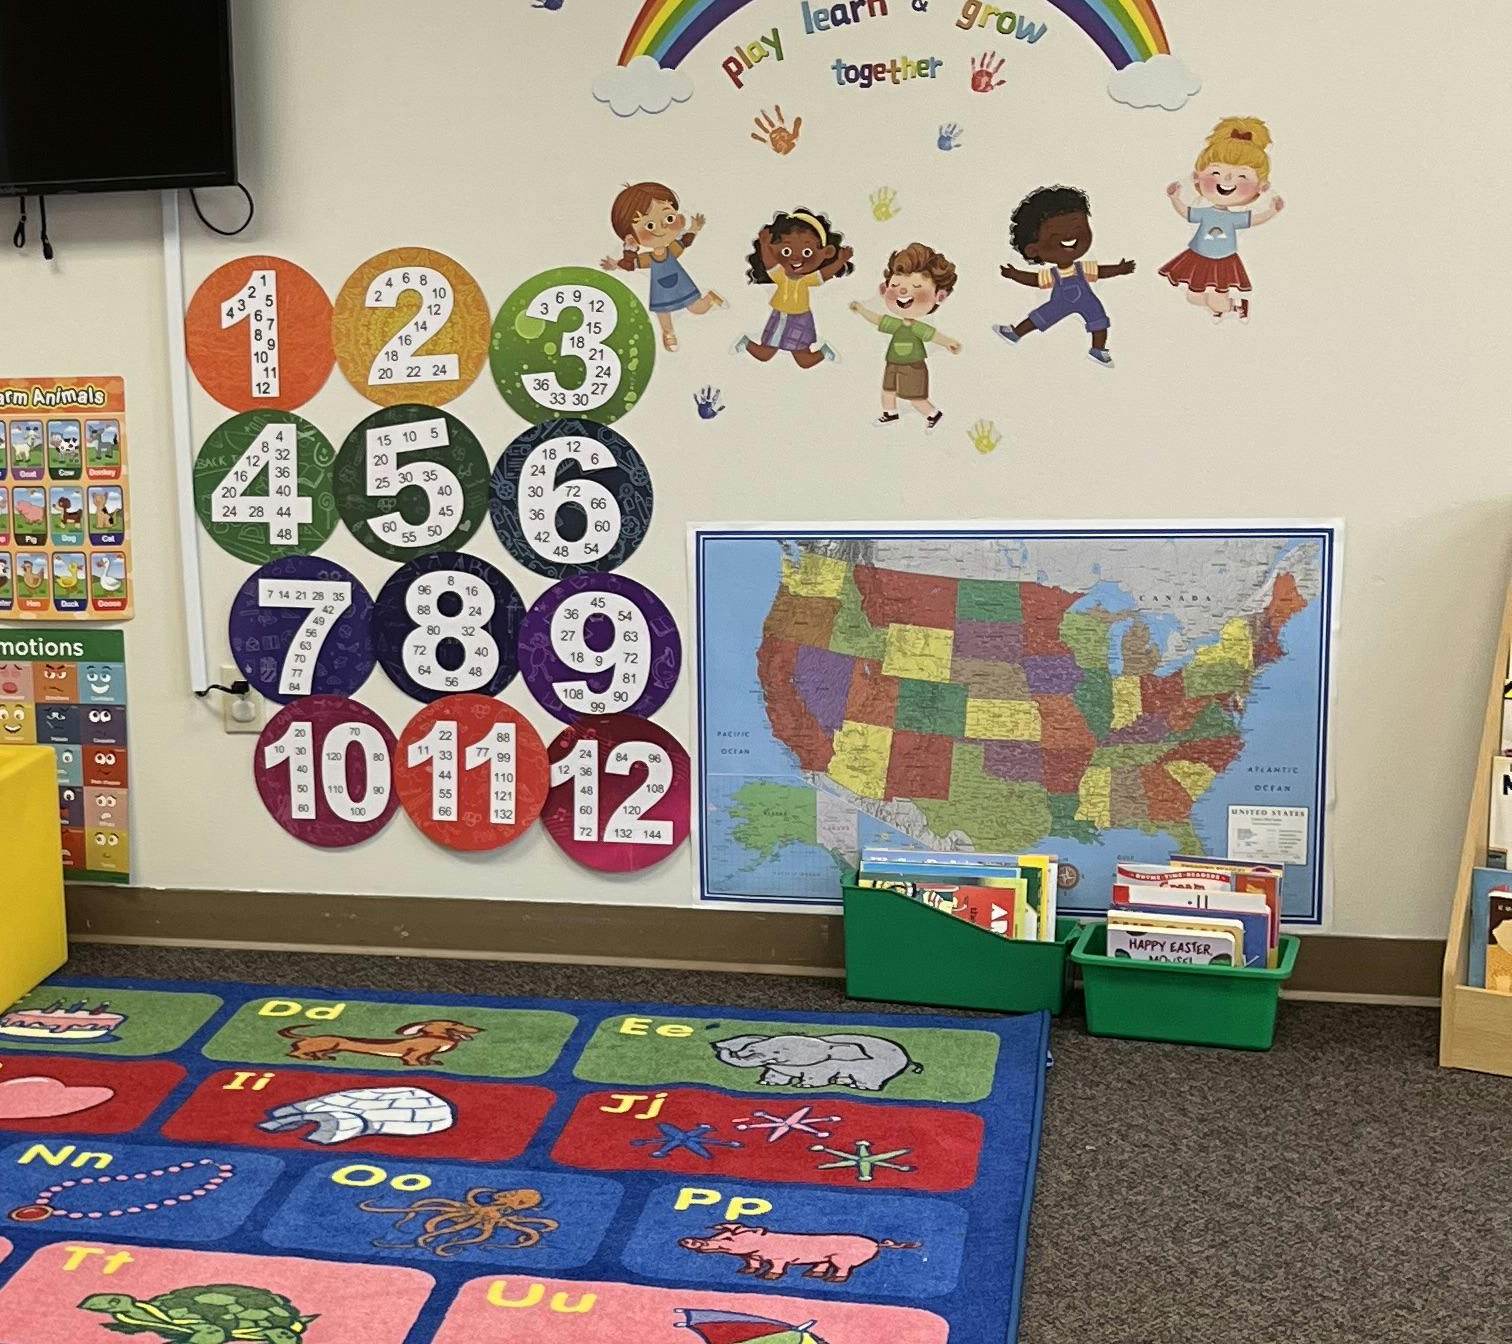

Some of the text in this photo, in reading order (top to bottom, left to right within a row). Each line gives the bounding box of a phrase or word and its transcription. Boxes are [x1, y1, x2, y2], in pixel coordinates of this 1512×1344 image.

[722, 28, 784, 89] play
[831, 56, 943, 89] together
[221, 270, 280, 398] 1
[365, 266, 460, 386] 2
[520, 284, 622, 412] 3
[378, 364, 447, 380] 20 22 24
[533, 378, 549, 392] 36
[32, 386, 105, 407] Animals
[211, 423, 313, 545] 4
[367, 417, 465, 548] 5
[518, 436, 622, 564] 6
[258, 578, 352, 695] 7
[402, 570, 500, 692] 8
[550, 590, 652, 714] 9
[562, 687, 583, 700] 108
[264, 721, 392, 823] 10
[407, 720, 517, 825] 11
[550, 739, 674, 846] 12
[1231, 809, 1305, 817] UNITED STATES
[614, 827, 662, 841] 132 144
[1129, 937, 1166, 953] HAPPY
[258, 1000, 346, 1021] Dd
[619, 1017, 696, 1038] Ee
[222, 1070, 276, 1092] Ii
[599, 1093, 668, 1120] Jj
[18, 1144, 113, 1169] Nn
[331, 1164, 432, 1192] Oo
[674, 1187, 773, 1221] Pp
[62, 1246, 135, 1275] Tt
[487, 1280, 598, 1314] Uu
